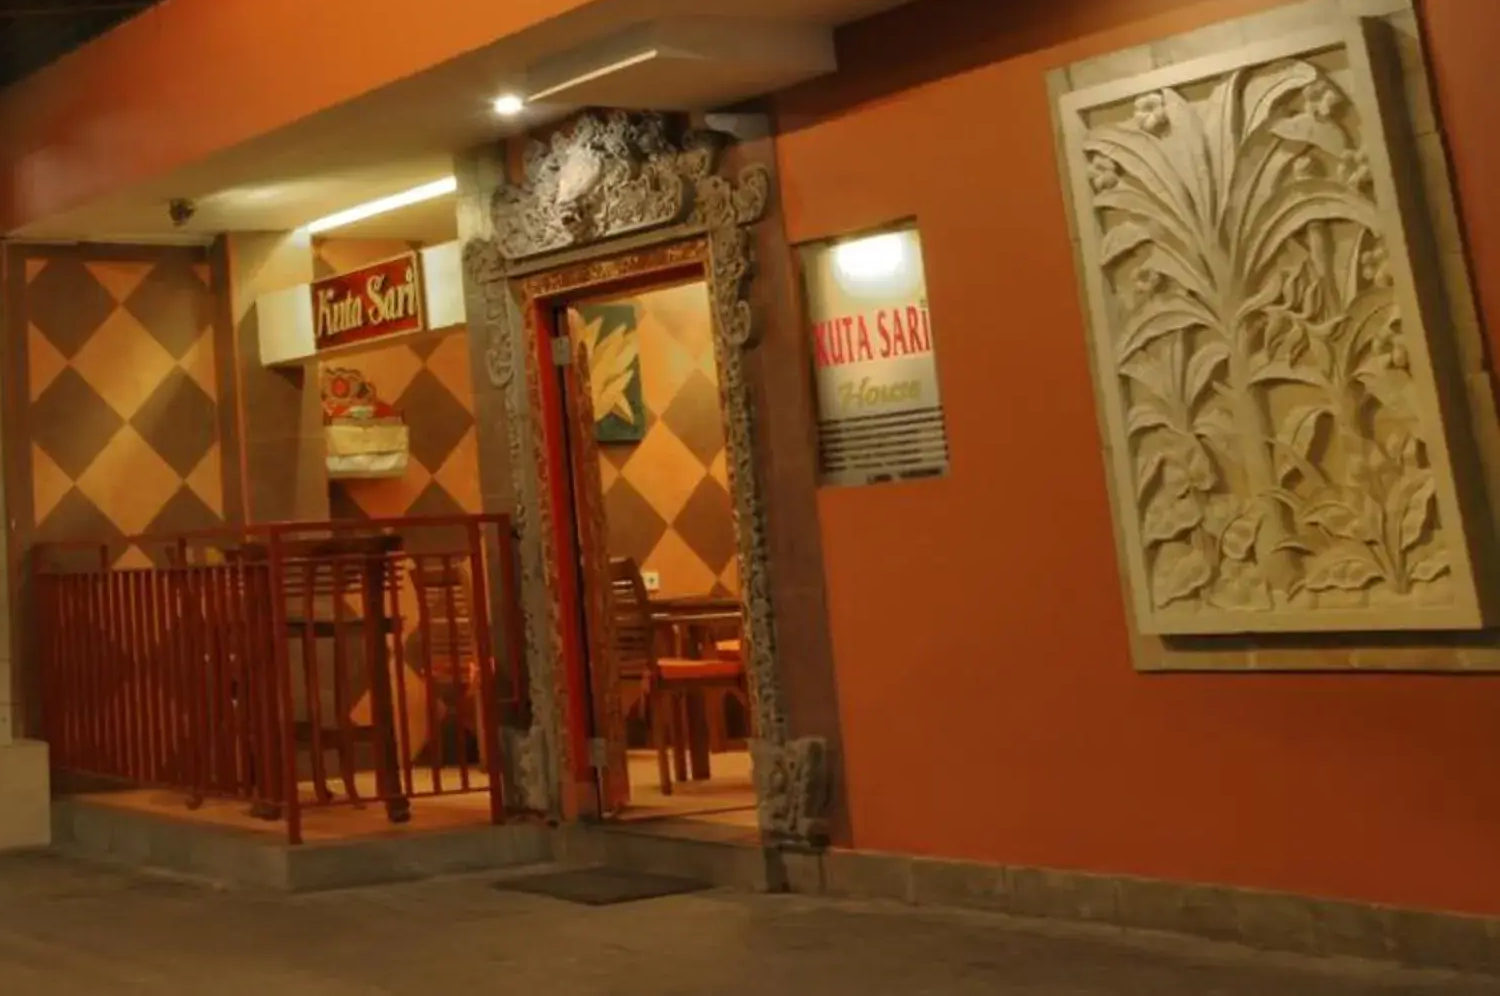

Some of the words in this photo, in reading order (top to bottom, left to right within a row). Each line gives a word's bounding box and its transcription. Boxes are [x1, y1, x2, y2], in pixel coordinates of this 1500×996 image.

[317, 288, 363, 337] Kuta
[367, 266, 415, 324] Sari
[813, 314, 873, 369] KUTA
